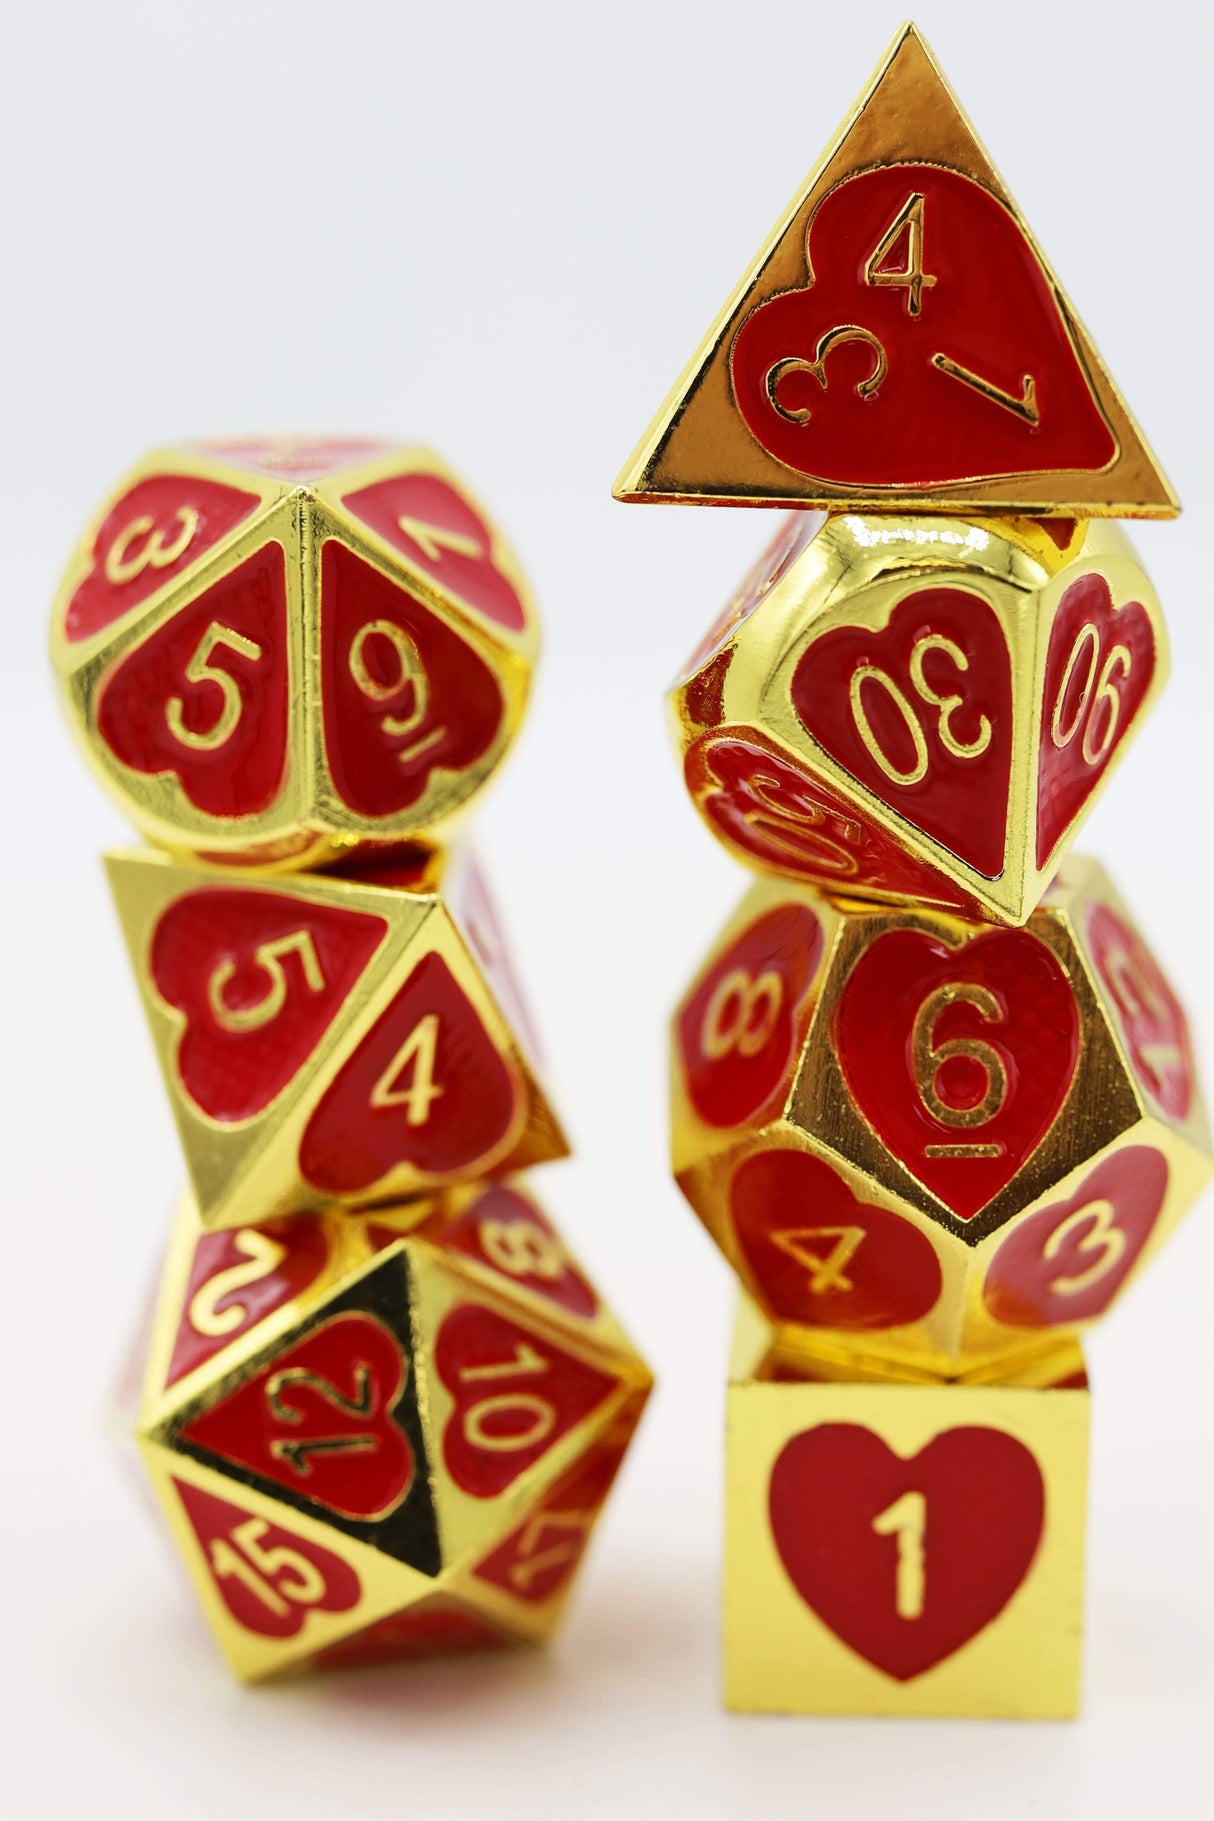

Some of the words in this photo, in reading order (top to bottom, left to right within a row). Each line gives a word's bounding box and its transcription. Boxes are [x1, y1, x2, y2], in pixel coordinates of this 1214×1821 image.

[865, 193, 937, 316] 4
[765, 325, 888, 423] 3
[932, 353, 1039, 426] 1
[106, 505, 199, 583] 3
[399, 515, 483, 561] 1
[165, 620, 262, 751] 5
[849, 632, 993, 786] 30
[744, 774, 862, 874] 50
[209, 929, 325, 1034] 5
[704, 968, 783, 1058] 8
[370, 1014, 443, 1127] 4
[912, 982, 1007, 1157] 6
[189, 1229, 286, 1337] 2
[771, 1225, 866, 1293] 4
[1042, 1198, 1126, 1296] 3
[266, 1359, 376, 1477] 12
[459, 1341, 557, 1452] 10
[210, 1518, 326, 1617] 15
[871, 1490, 927, 1620] 1
